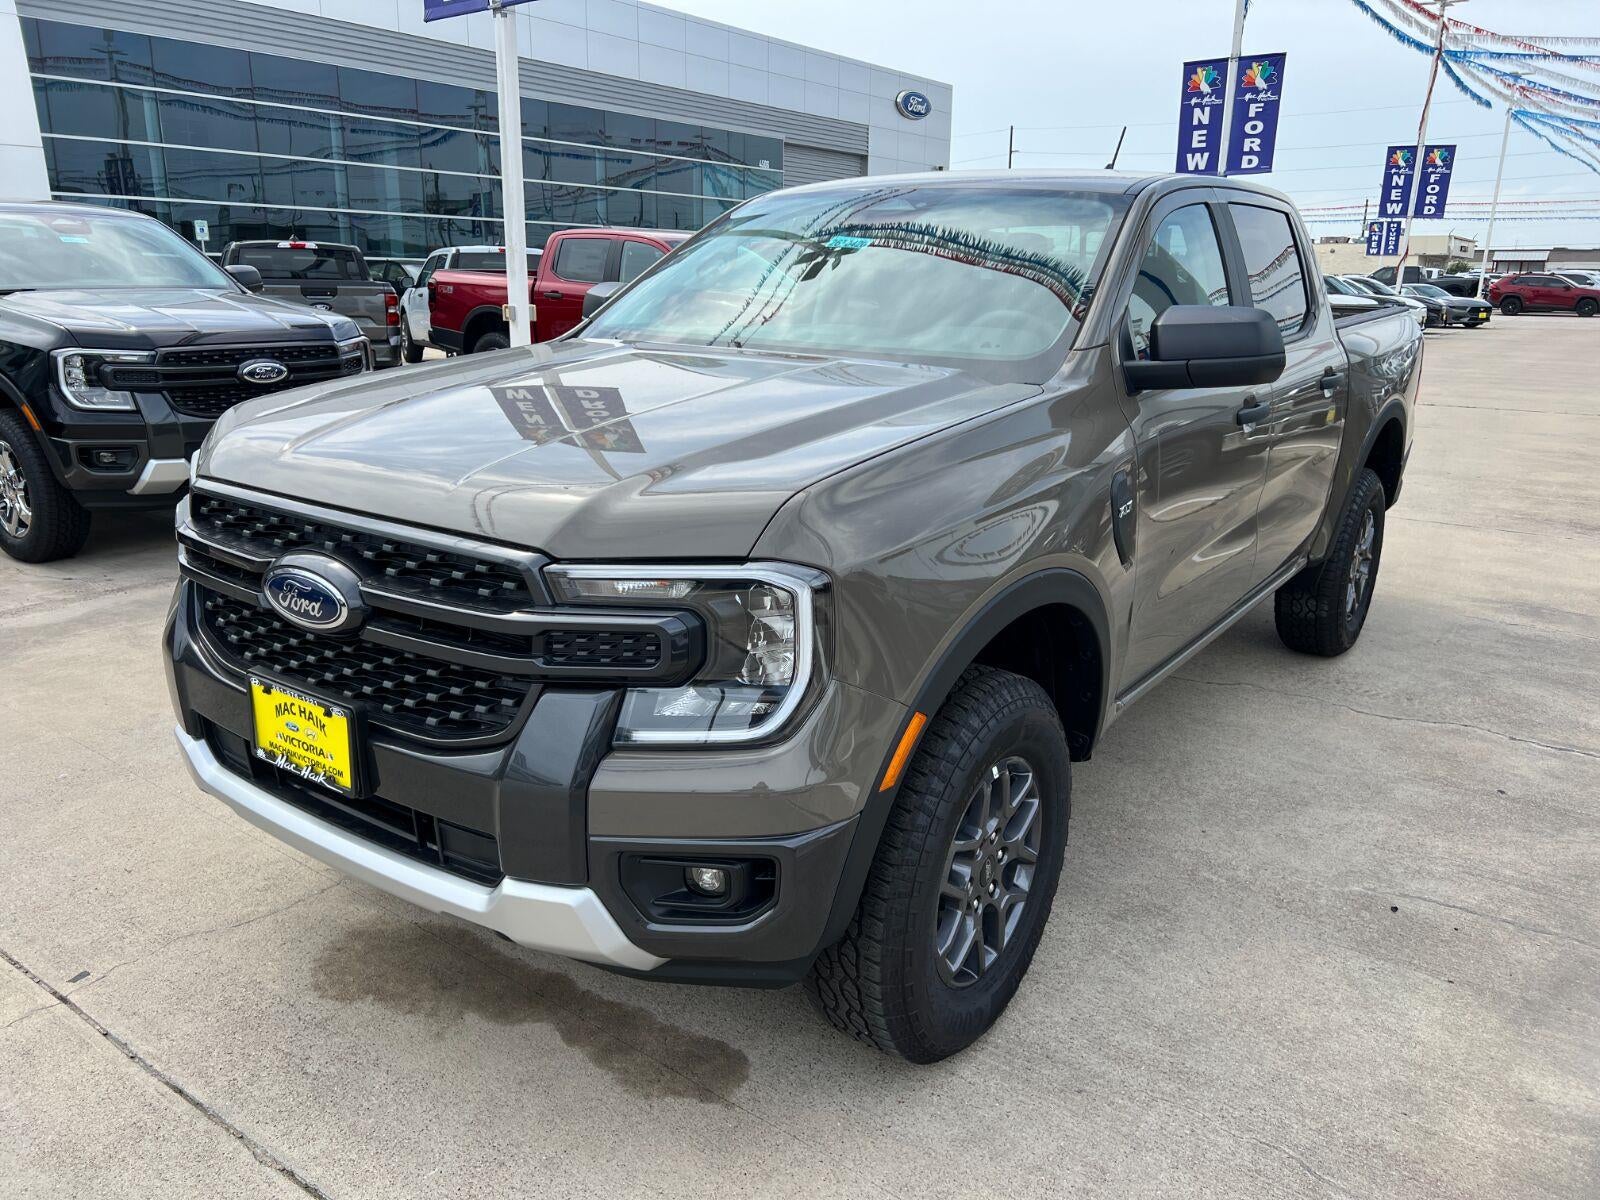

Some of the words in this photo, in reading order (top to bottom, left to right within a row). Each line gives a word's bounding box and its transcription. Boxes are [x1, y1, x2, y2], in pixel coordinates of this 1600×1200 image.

[908, 96, 927, 114] Ford
[1186, 106, 1210, 171] NEW
[1241, 103, 1265, 168] FORD
[1386, 175, 1405, 214] NEW
[1423, 174, 1441, 214] FORD
[1370, 235, 1379, 254] NEW
[1387, 223, 1397, 254] HYUNDAI
[254, 366, 278, 379] Ford
[279, 579, 323, 617] Ford
[275, 702, 296, 718] MAC
[298, 705, 327, 737] HAIK
[281, 732, 325, 759] VICTORIA
[275, 753, 300, 774] Mac
